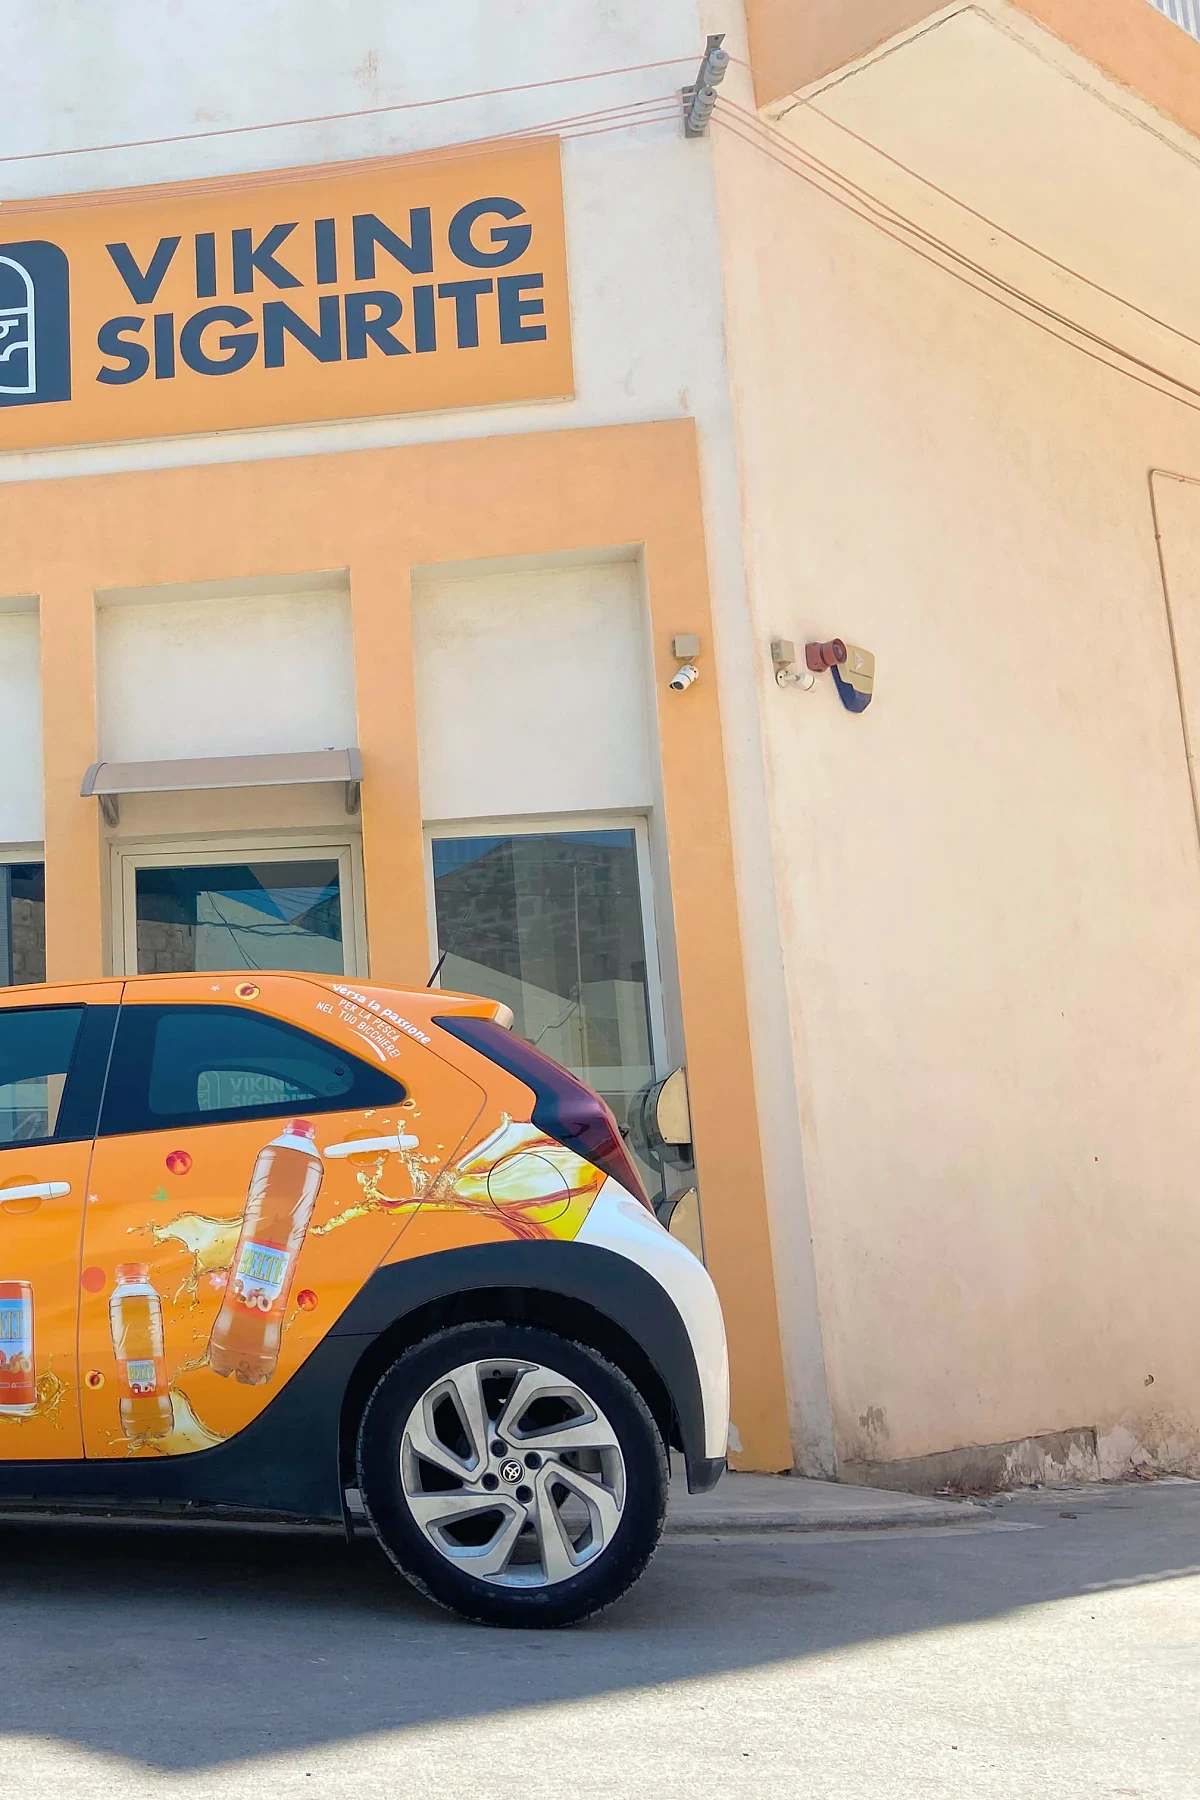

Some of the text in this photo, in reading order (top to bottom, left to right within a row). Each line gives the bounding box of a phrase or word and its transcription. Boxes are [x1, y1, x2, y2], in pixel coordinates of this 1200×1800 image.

[105, 195, 533, 305] VIKING
[95, 272, 548, 386] SIGNRITE
[316, 1001, 402, 1059] NEL TUO BICCHIERE!
[333, 984, 431, 1044] versa la passione
[338, 998, 401, 1042] PER LA PESCA
